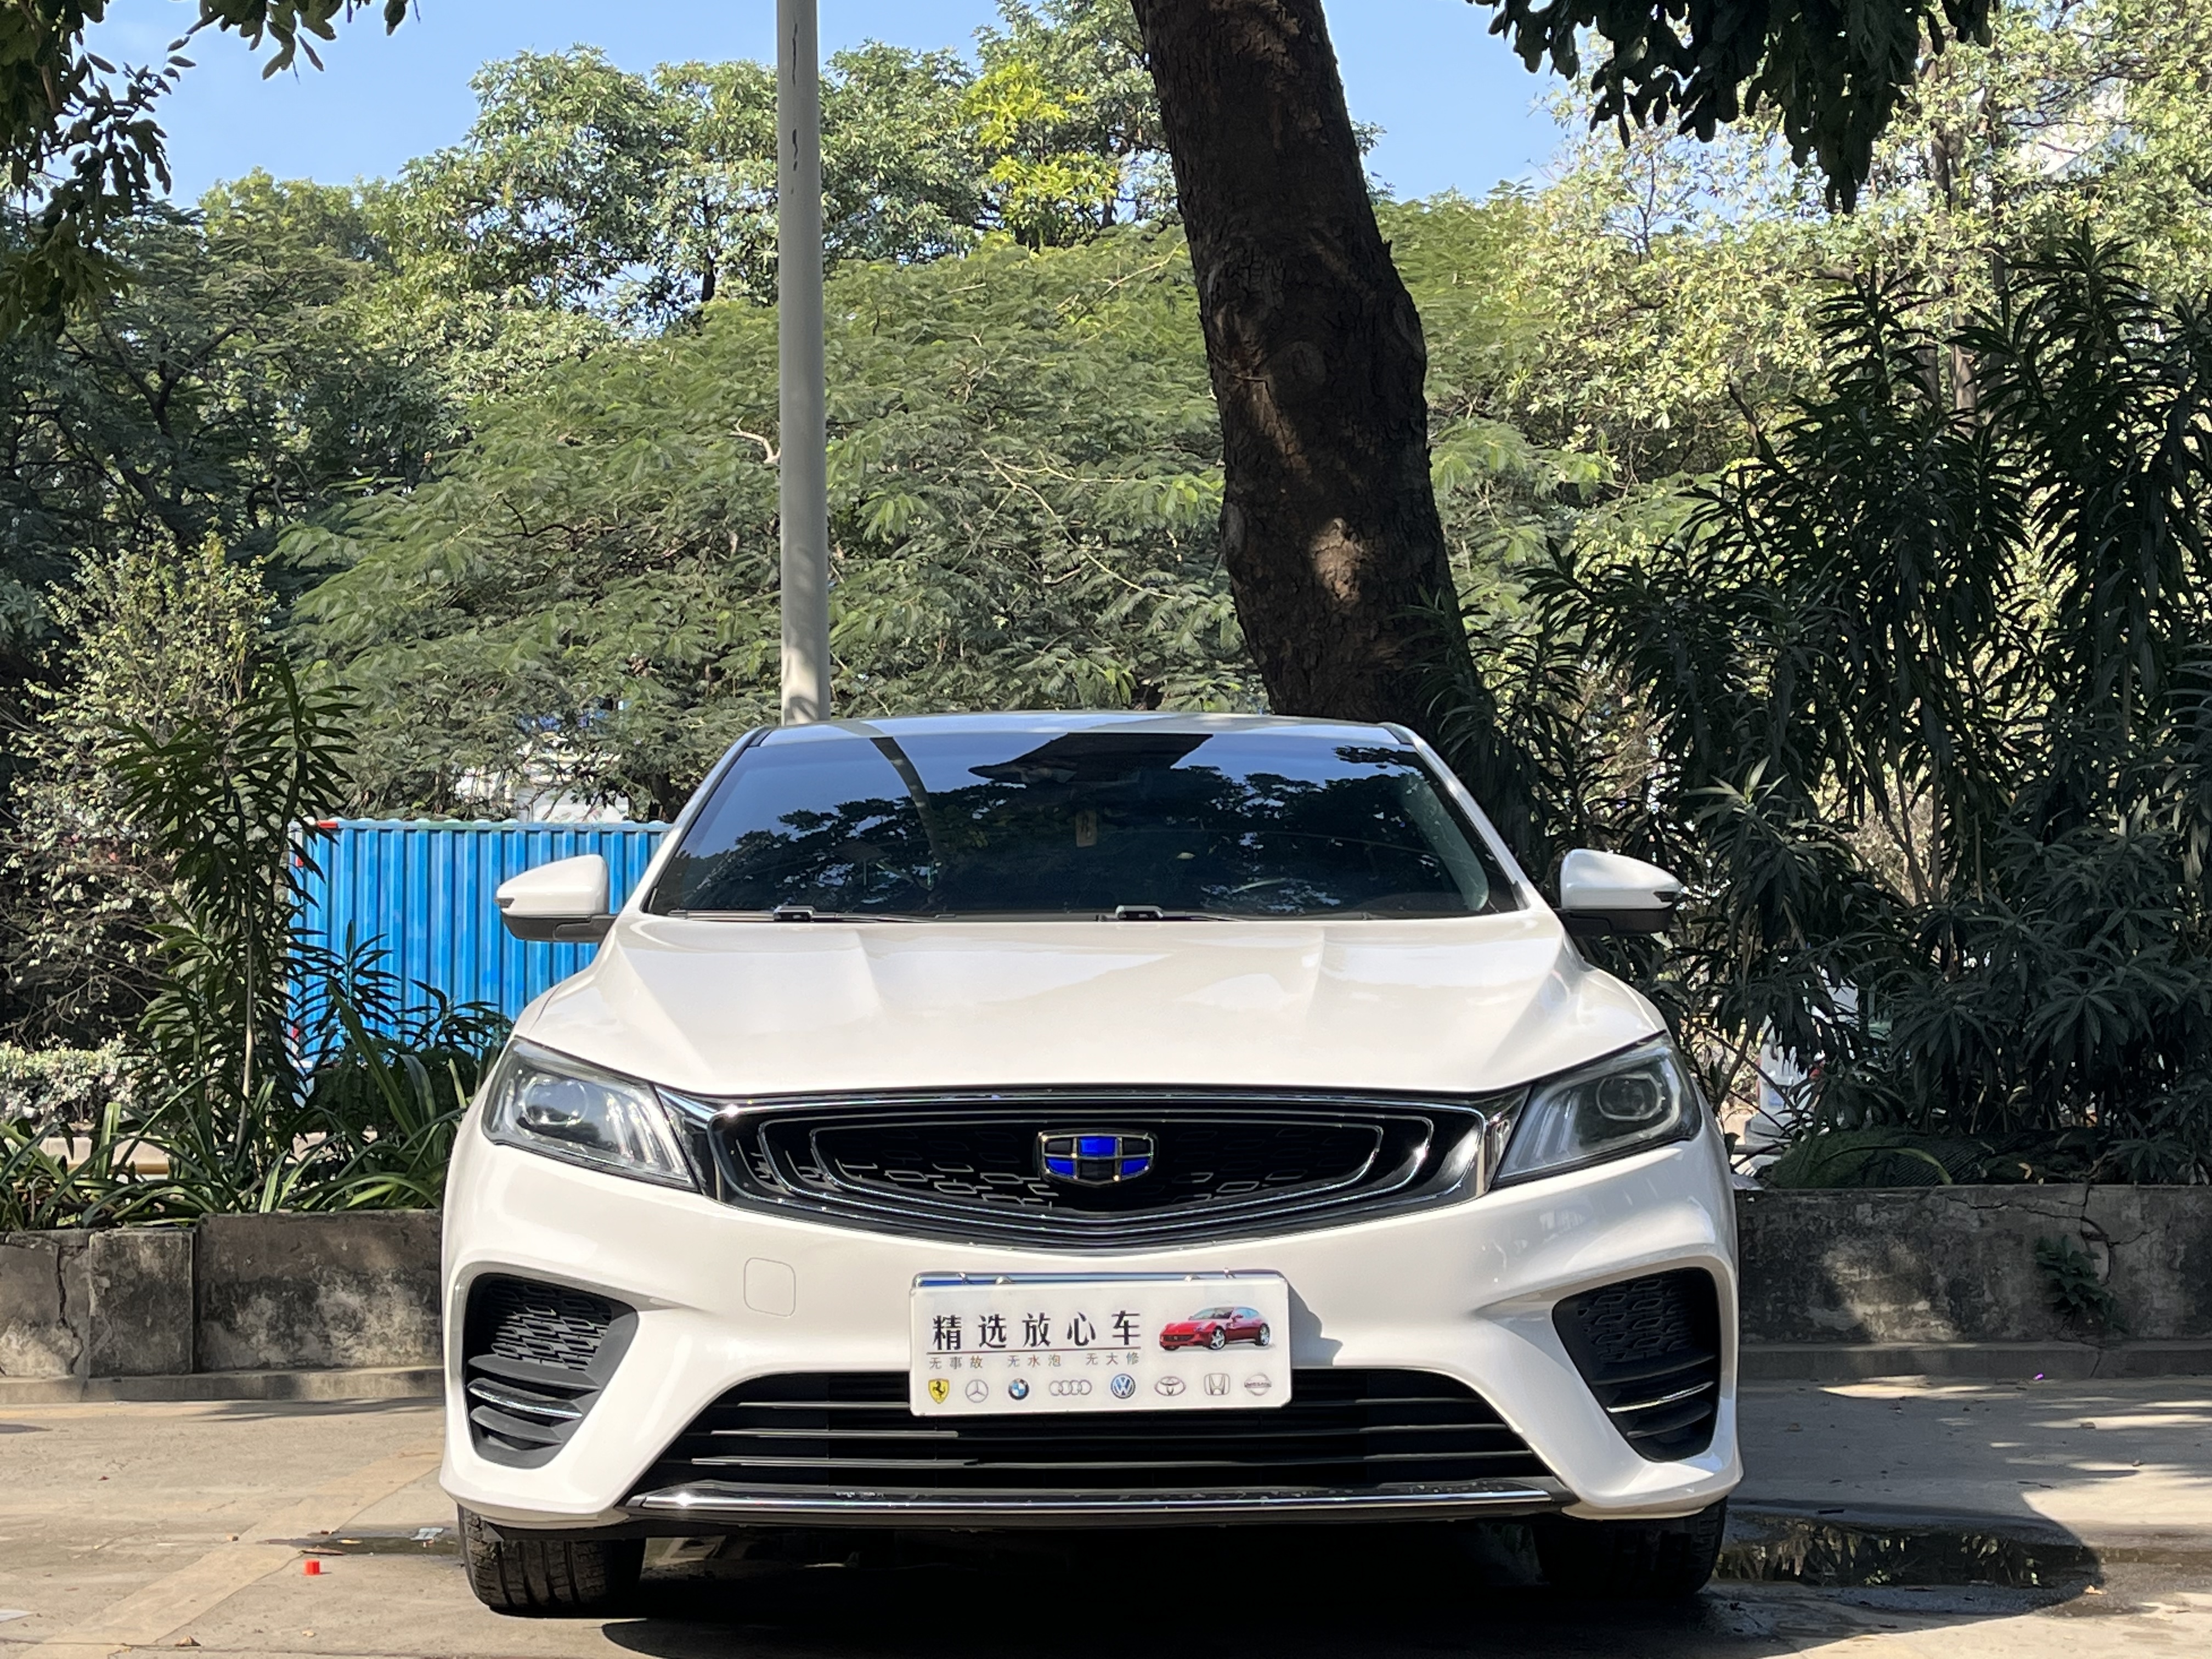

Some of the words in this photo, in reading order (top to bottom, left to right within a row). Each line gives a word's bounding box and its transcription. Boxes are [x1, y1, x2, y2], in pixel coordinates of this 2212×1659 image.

[933, 1310, 1141, 1350] 精选放心车
[929, 1355, 984, 1369] 无事故
[1007, 1353, 1062, 1368] 无水泡
[1085, 1351, 1139, 1365] 无大修
